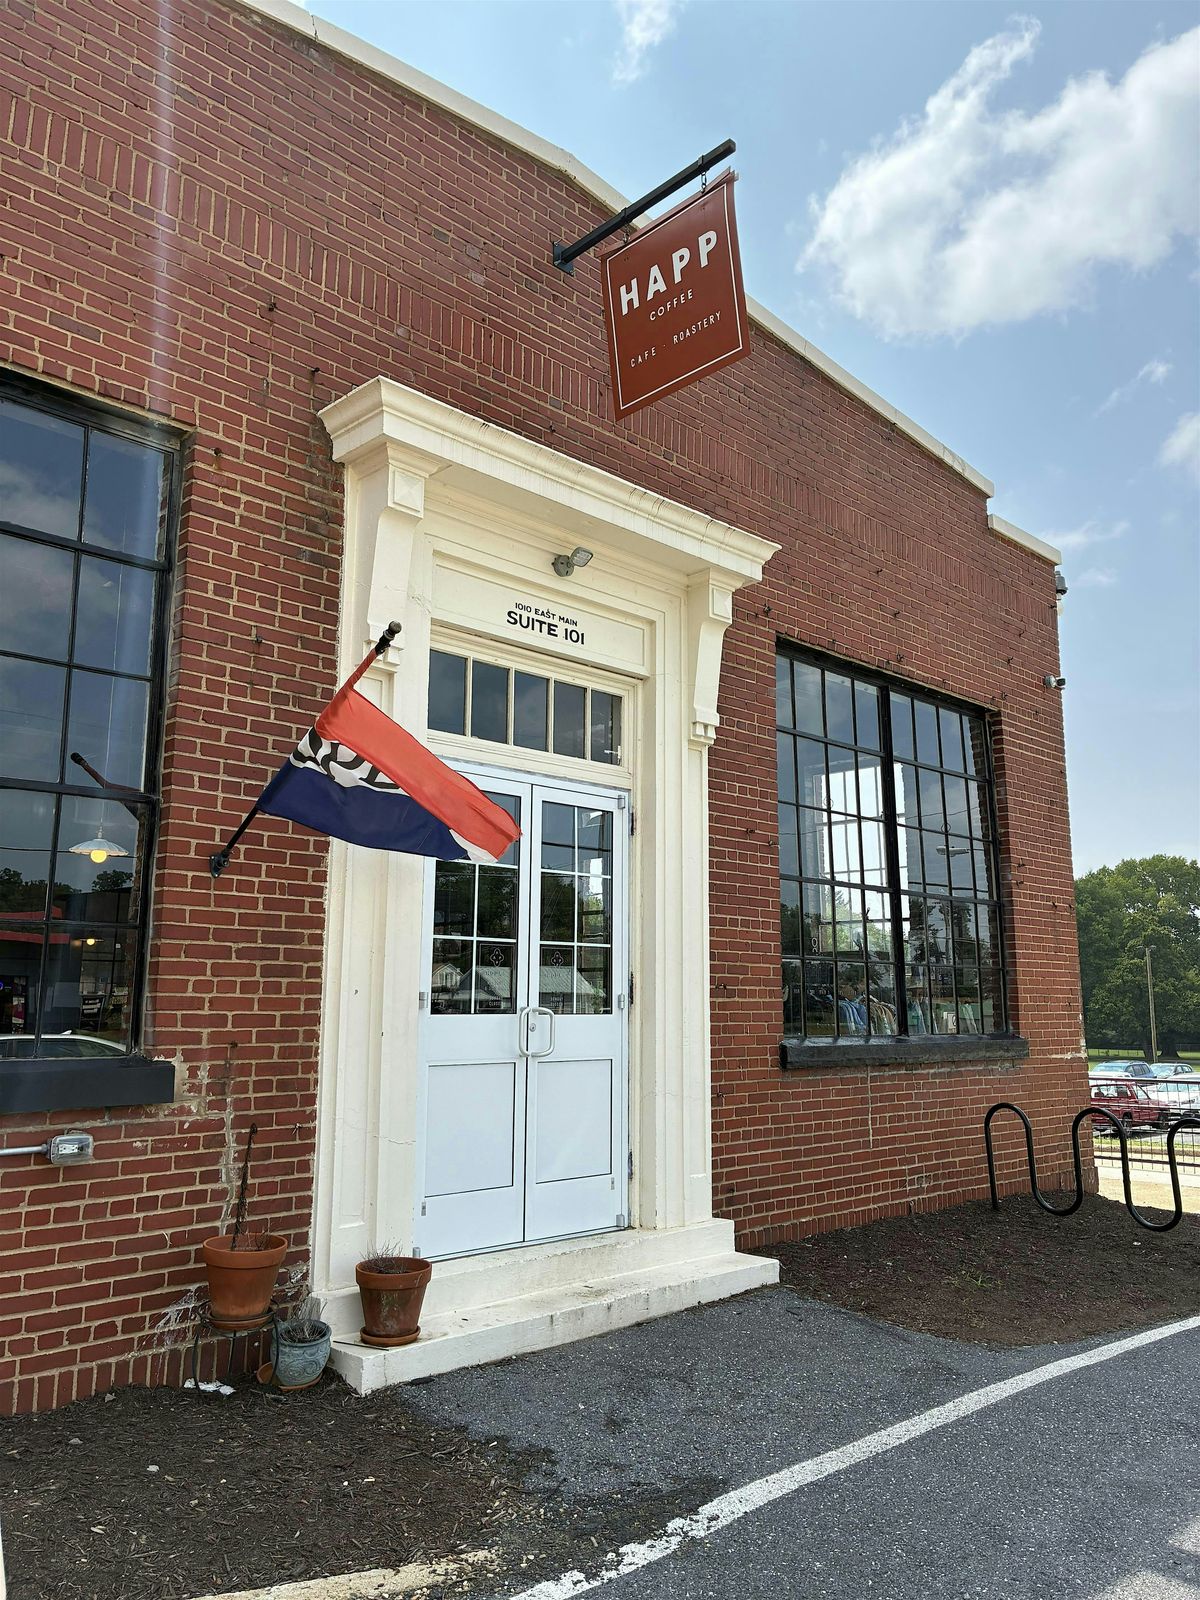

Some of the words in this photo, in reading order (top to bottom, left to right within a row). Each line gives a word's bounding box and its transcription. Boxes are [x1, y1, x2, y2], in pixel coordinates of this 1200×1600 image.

[619, 230, 718, 316] HAPP
[649, 289, 694, 322] COFFEE
[630, 345, 657, 368] CAFE
[673, 310, 722, 345] ROASTERY
[506, 610, 558, 637] SUITE
[564, 628, 585, 645] 101
[515, 602, 532, 613] 1010
[534, 608, 556, 620] EAST
[558, 615, 578, 627] MAIN
